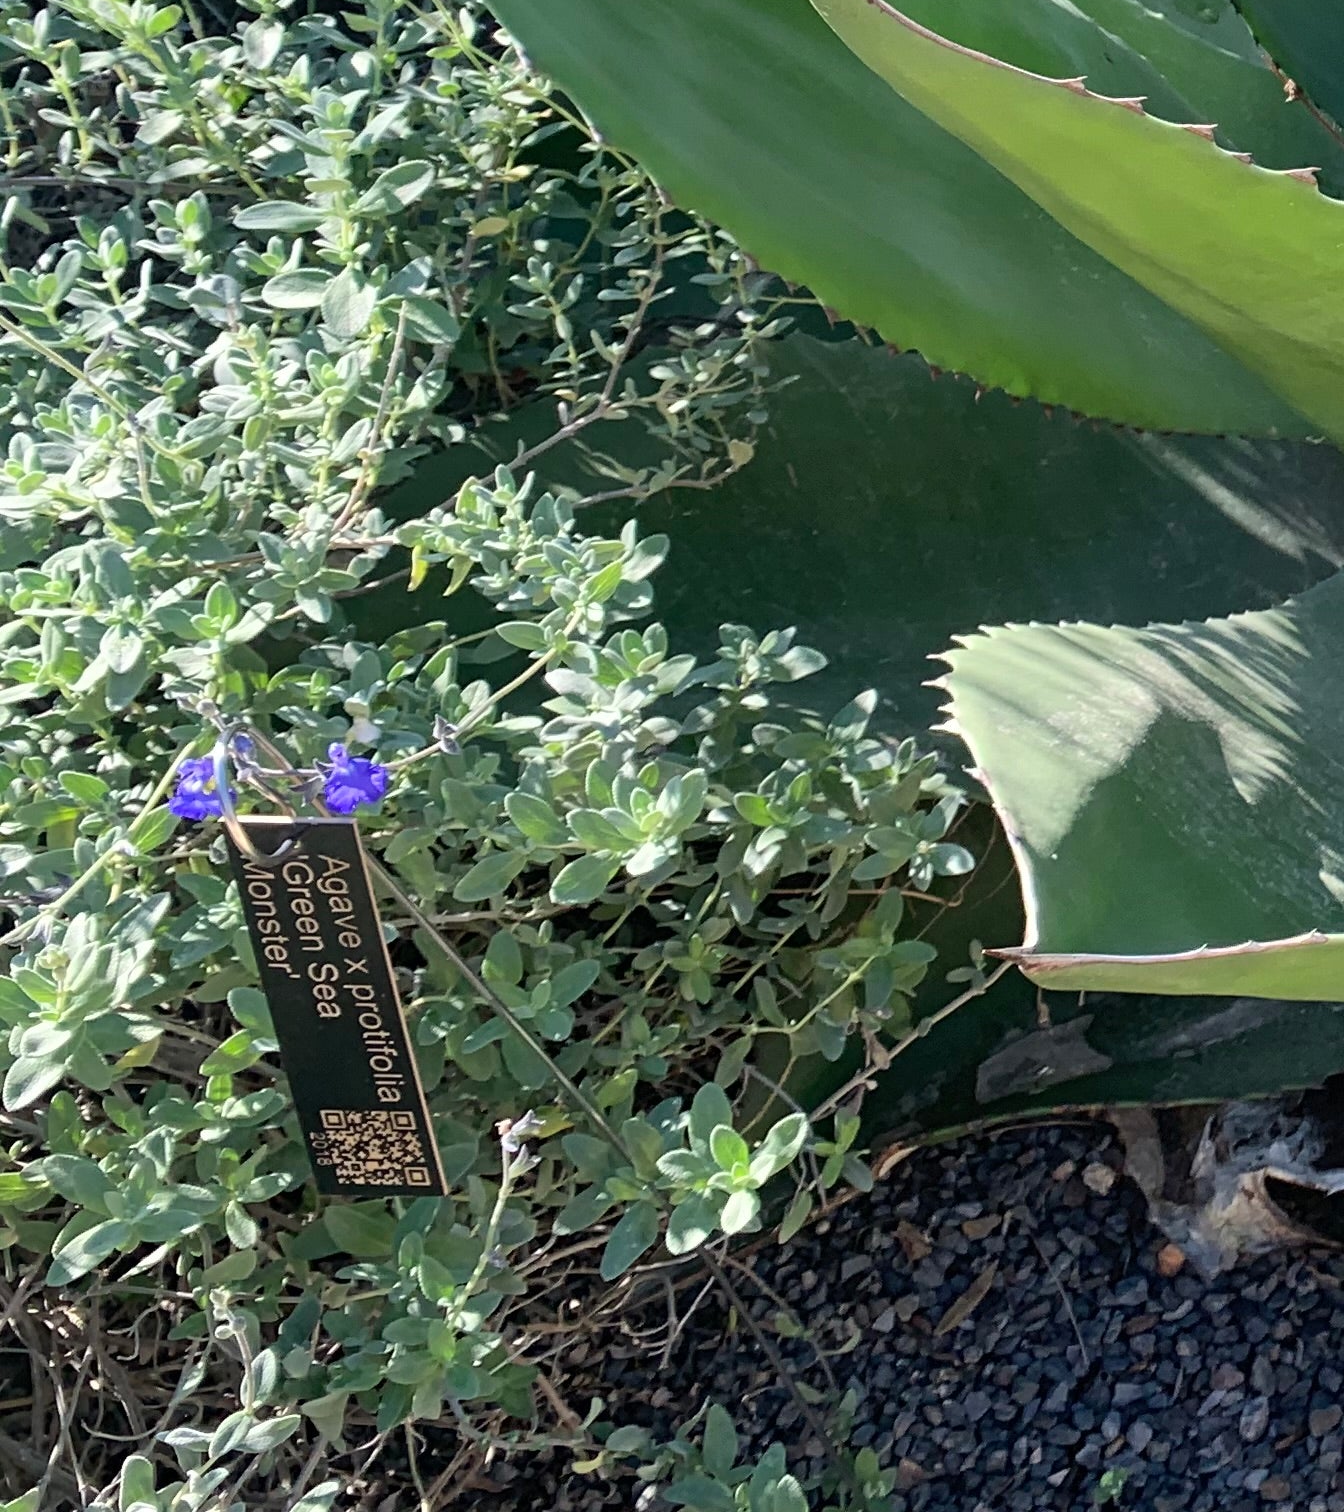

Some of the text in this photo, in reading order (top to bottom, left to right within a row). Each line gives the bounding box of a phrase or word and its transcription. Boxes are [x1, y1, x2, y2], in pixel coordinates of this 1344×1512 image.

[307, 963, 340, 1019] Sea
[317, 855, 405, 1104] Agave x protifolia
[310, 1131, 332, 1166] 2018
